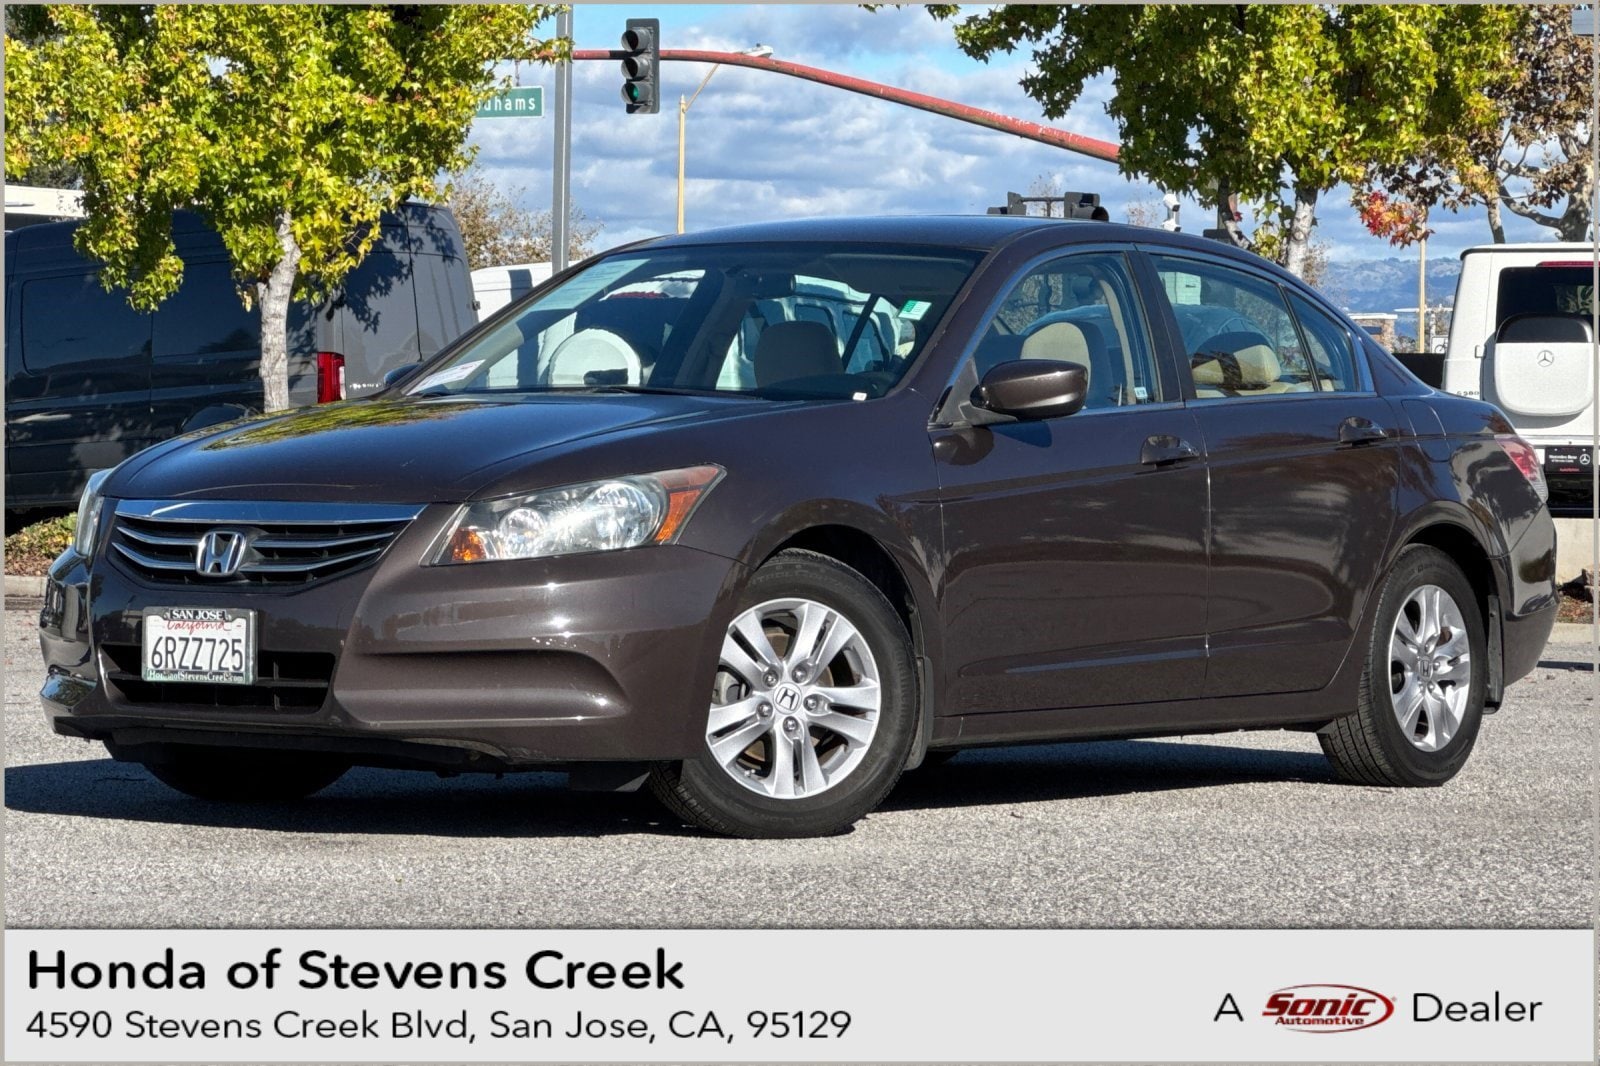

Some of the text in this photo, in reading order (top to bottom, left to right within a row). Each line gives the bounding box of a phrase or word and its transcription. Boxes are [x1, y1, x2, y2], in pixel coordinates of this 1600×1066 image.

[172, 610, 223, 620] SAN JOSE
[151, 636, 243, 671] 6RZZ725
